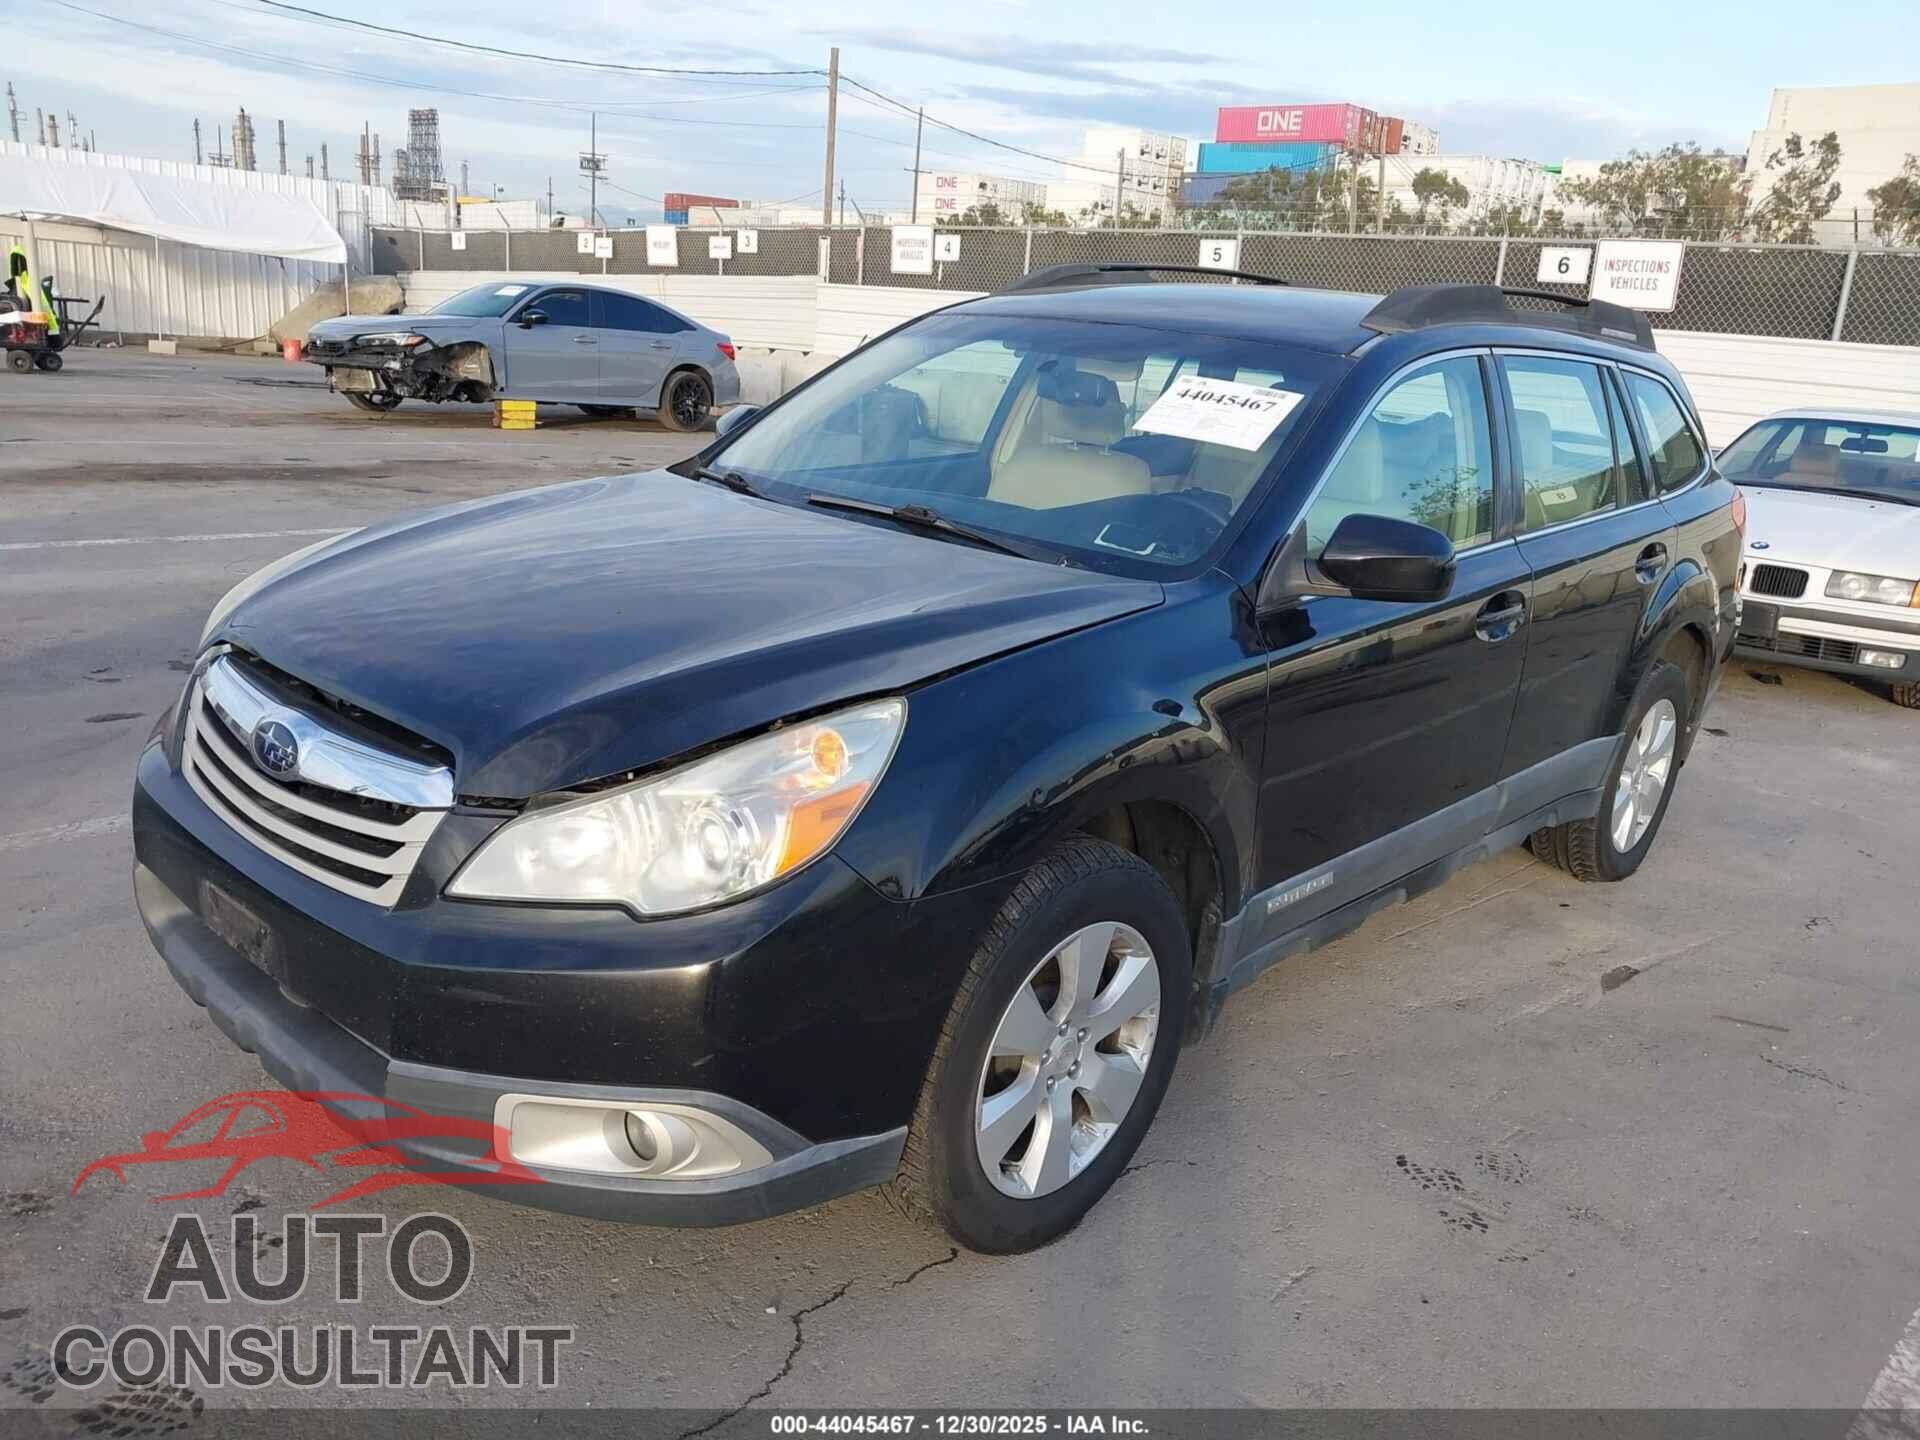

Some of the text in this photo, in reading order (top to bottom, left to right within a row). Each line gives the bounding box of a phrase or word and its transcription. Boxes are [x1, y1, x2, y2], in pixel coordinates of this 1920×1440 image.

[1257, 110, 1303, 132] ONE
[936, 176, 958, 188] ONE
[935, 198, 957, 209] ONE
[744, 235, 751, 248] 3
[944, 241, 952, 253] 4
[1212, 247, 1222, 262] 5
[1557, 256, 1570, 274] 6
[1604, 258, 1671, 274] INSPECTIONS
[1610, 277, 1658, 292] VEHICLES
[1177, 388, 1277, 412] 44045467
